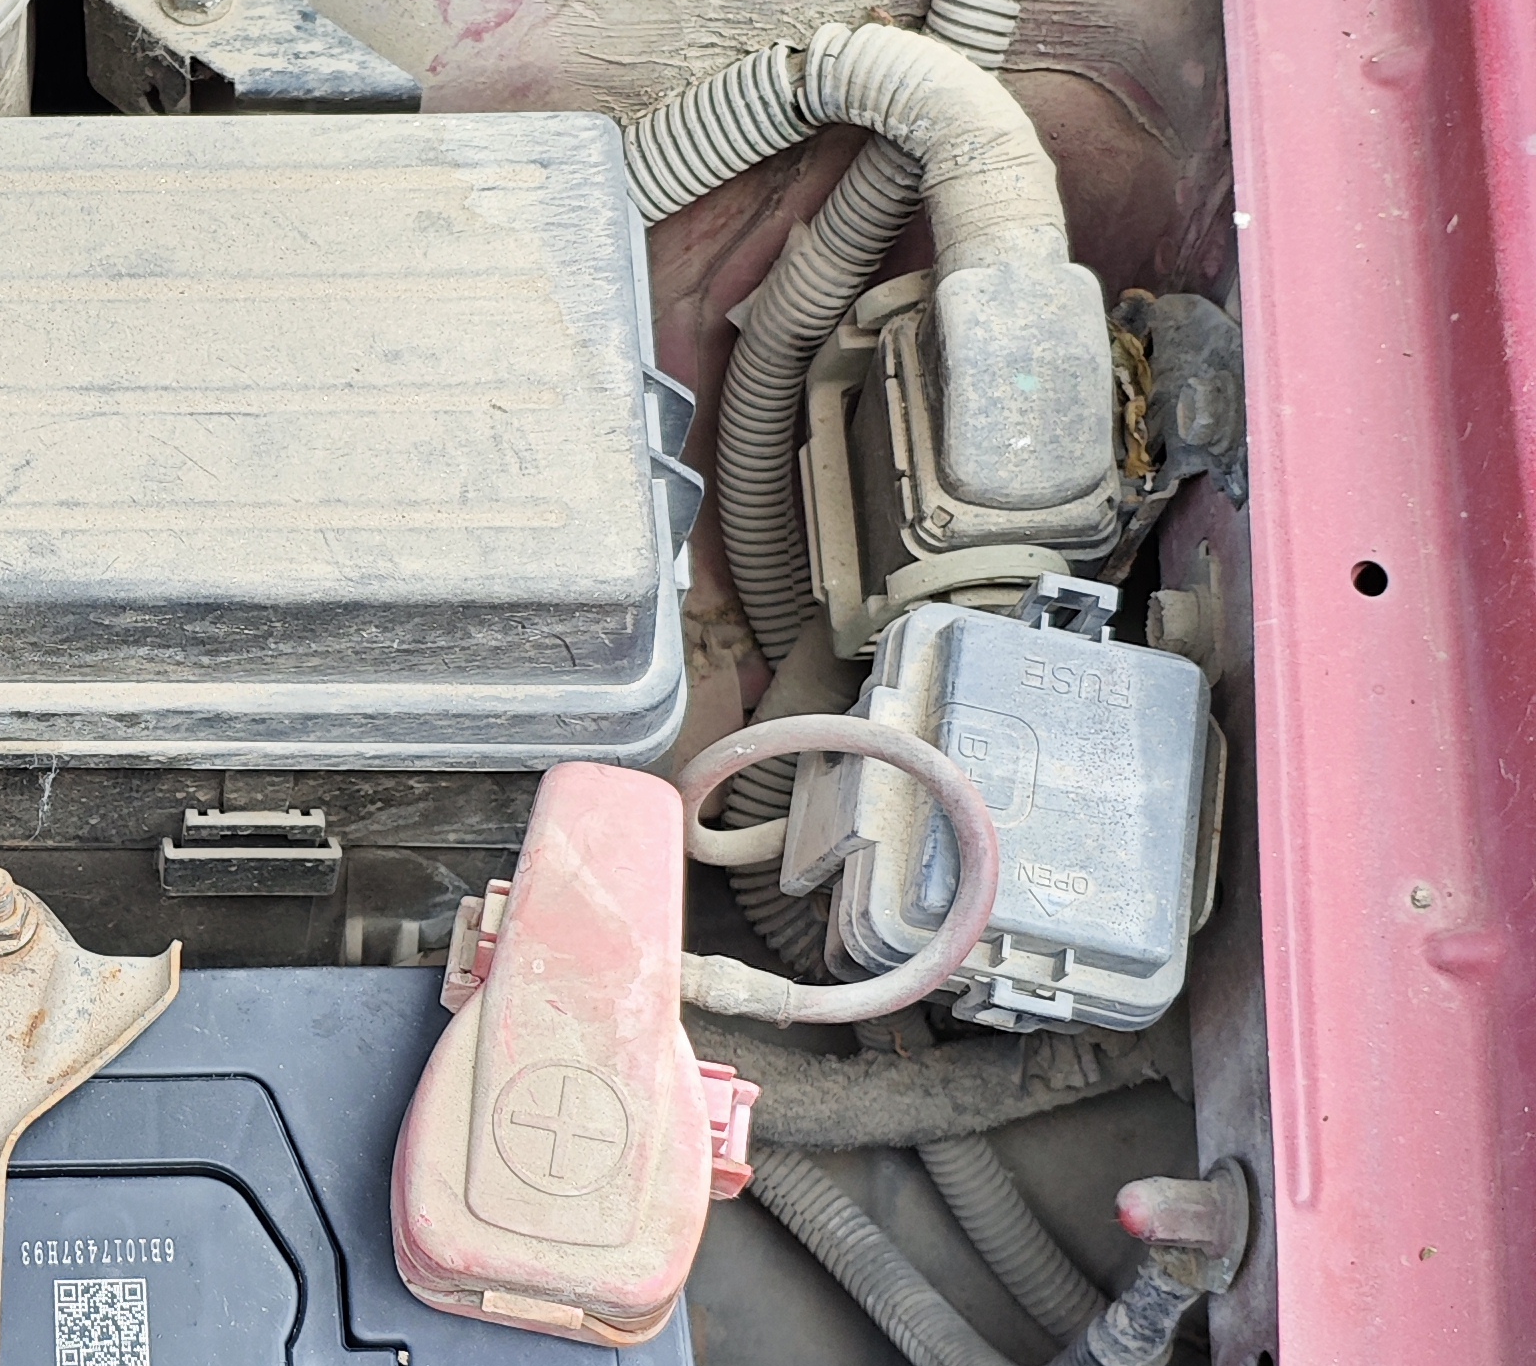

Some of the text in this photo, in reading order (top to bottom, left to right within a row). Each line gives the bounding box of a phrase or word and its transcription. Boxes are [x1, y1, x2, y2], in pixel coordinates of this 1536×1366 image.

[1020, 656, 1134, 710] FUSE
[1017, 861, 1090, 896] OPEN
[20, 1237, 175, 1266] 6B1017437H93
